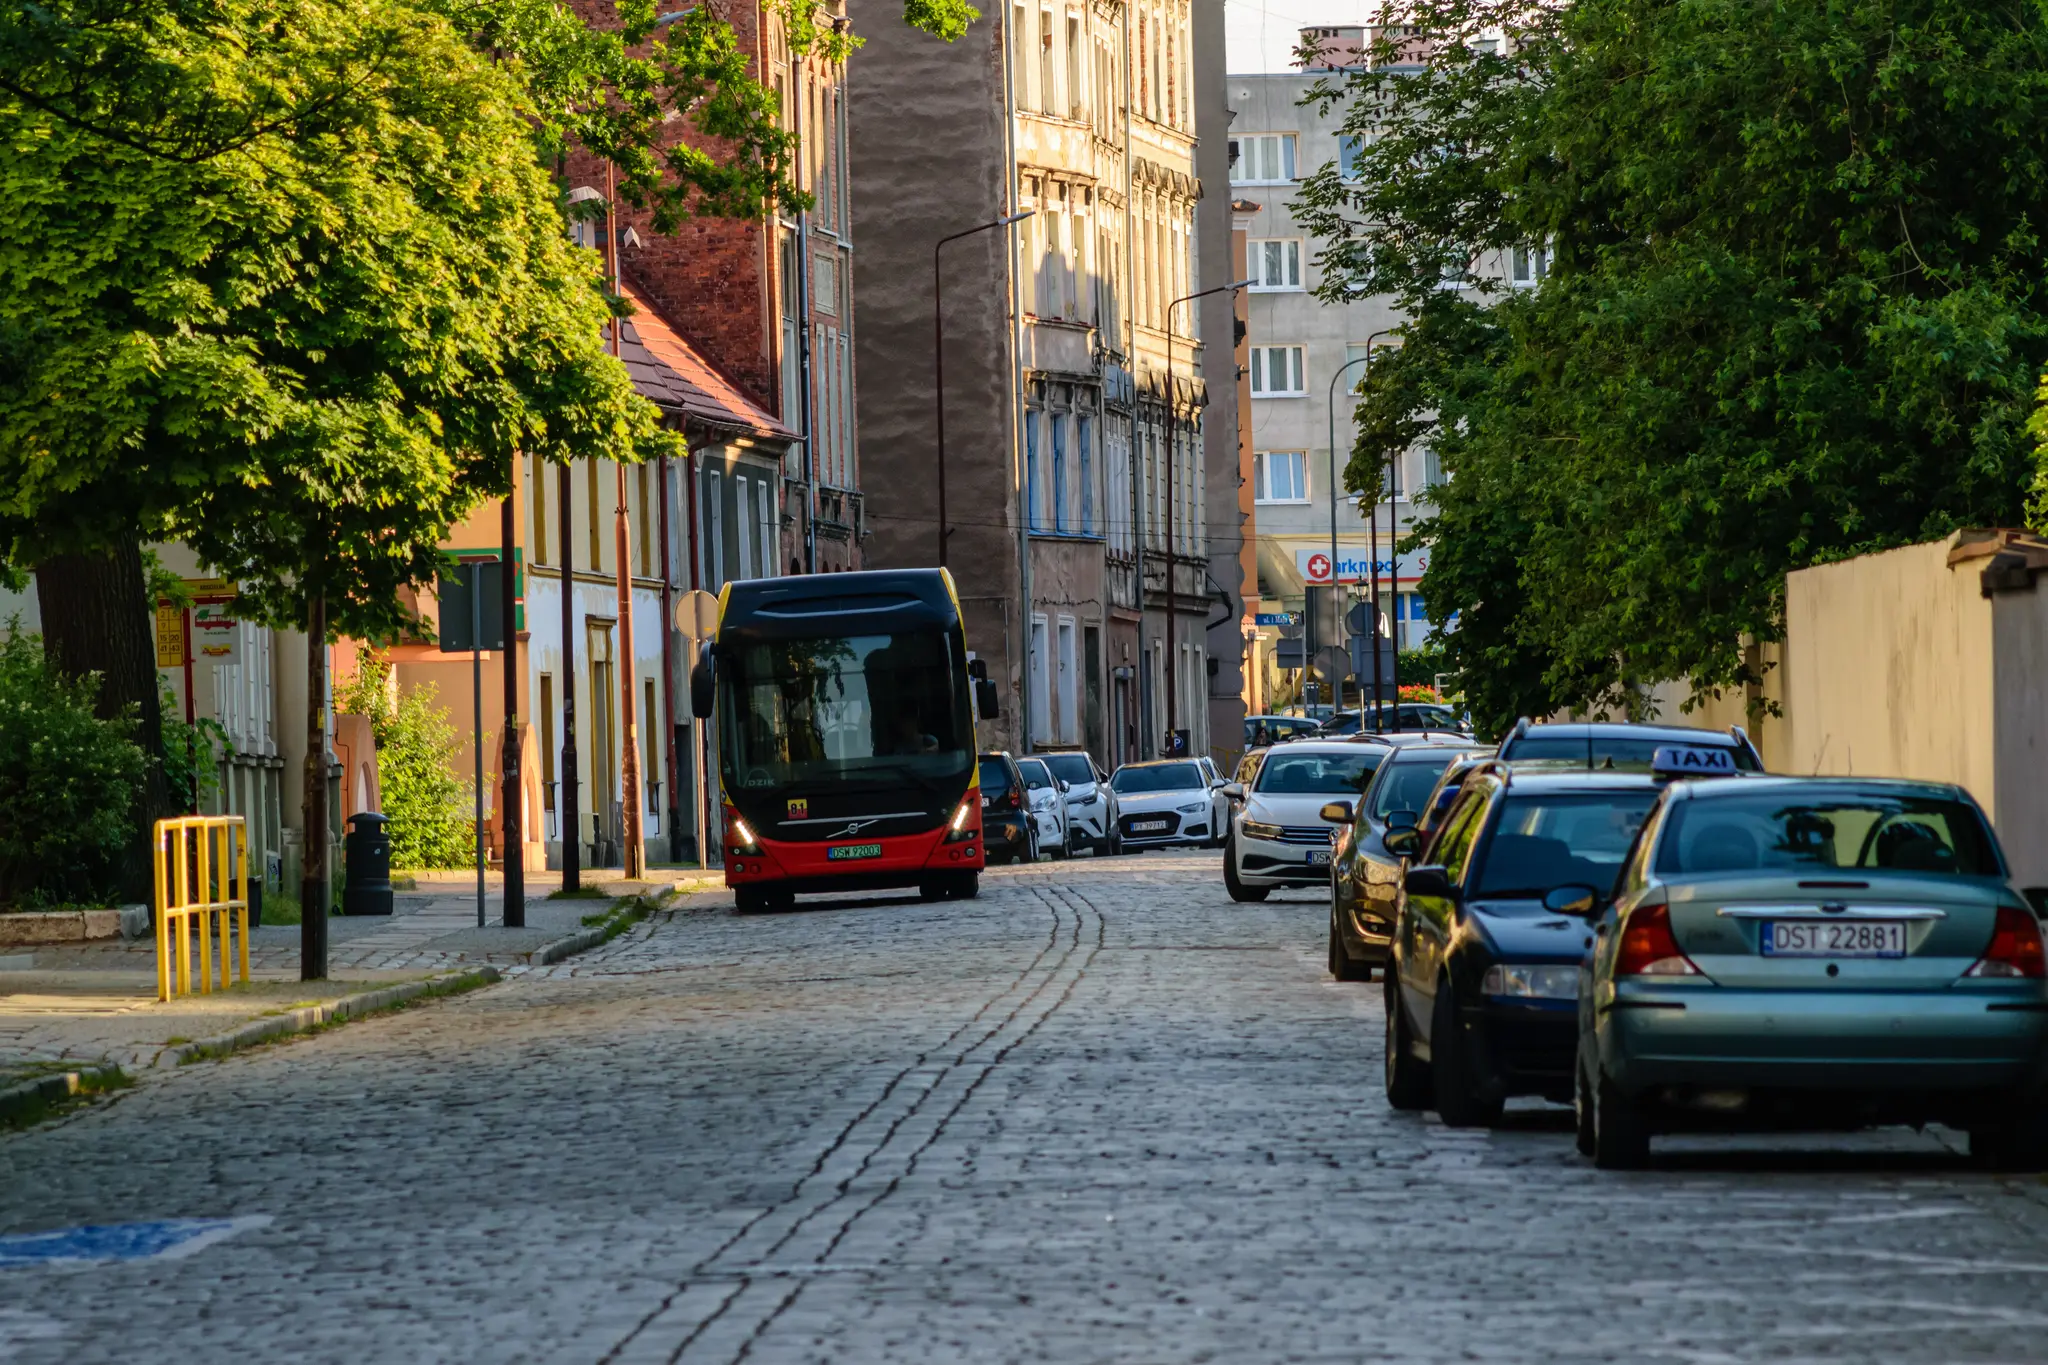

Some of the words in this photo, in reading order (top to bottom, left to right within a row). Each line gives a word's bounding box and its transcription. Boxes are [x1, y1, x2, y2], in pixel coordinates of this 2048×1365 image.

[1666, 750, 1728, 769] TAXI
[748, 778, 775, 787] DZIK
[791, 803, 804, 815] 81
[852, 845, 880, 857] 92003
[1775, 926, 1819, 949] DST
[1829, 926, 1898, 949] 22881
